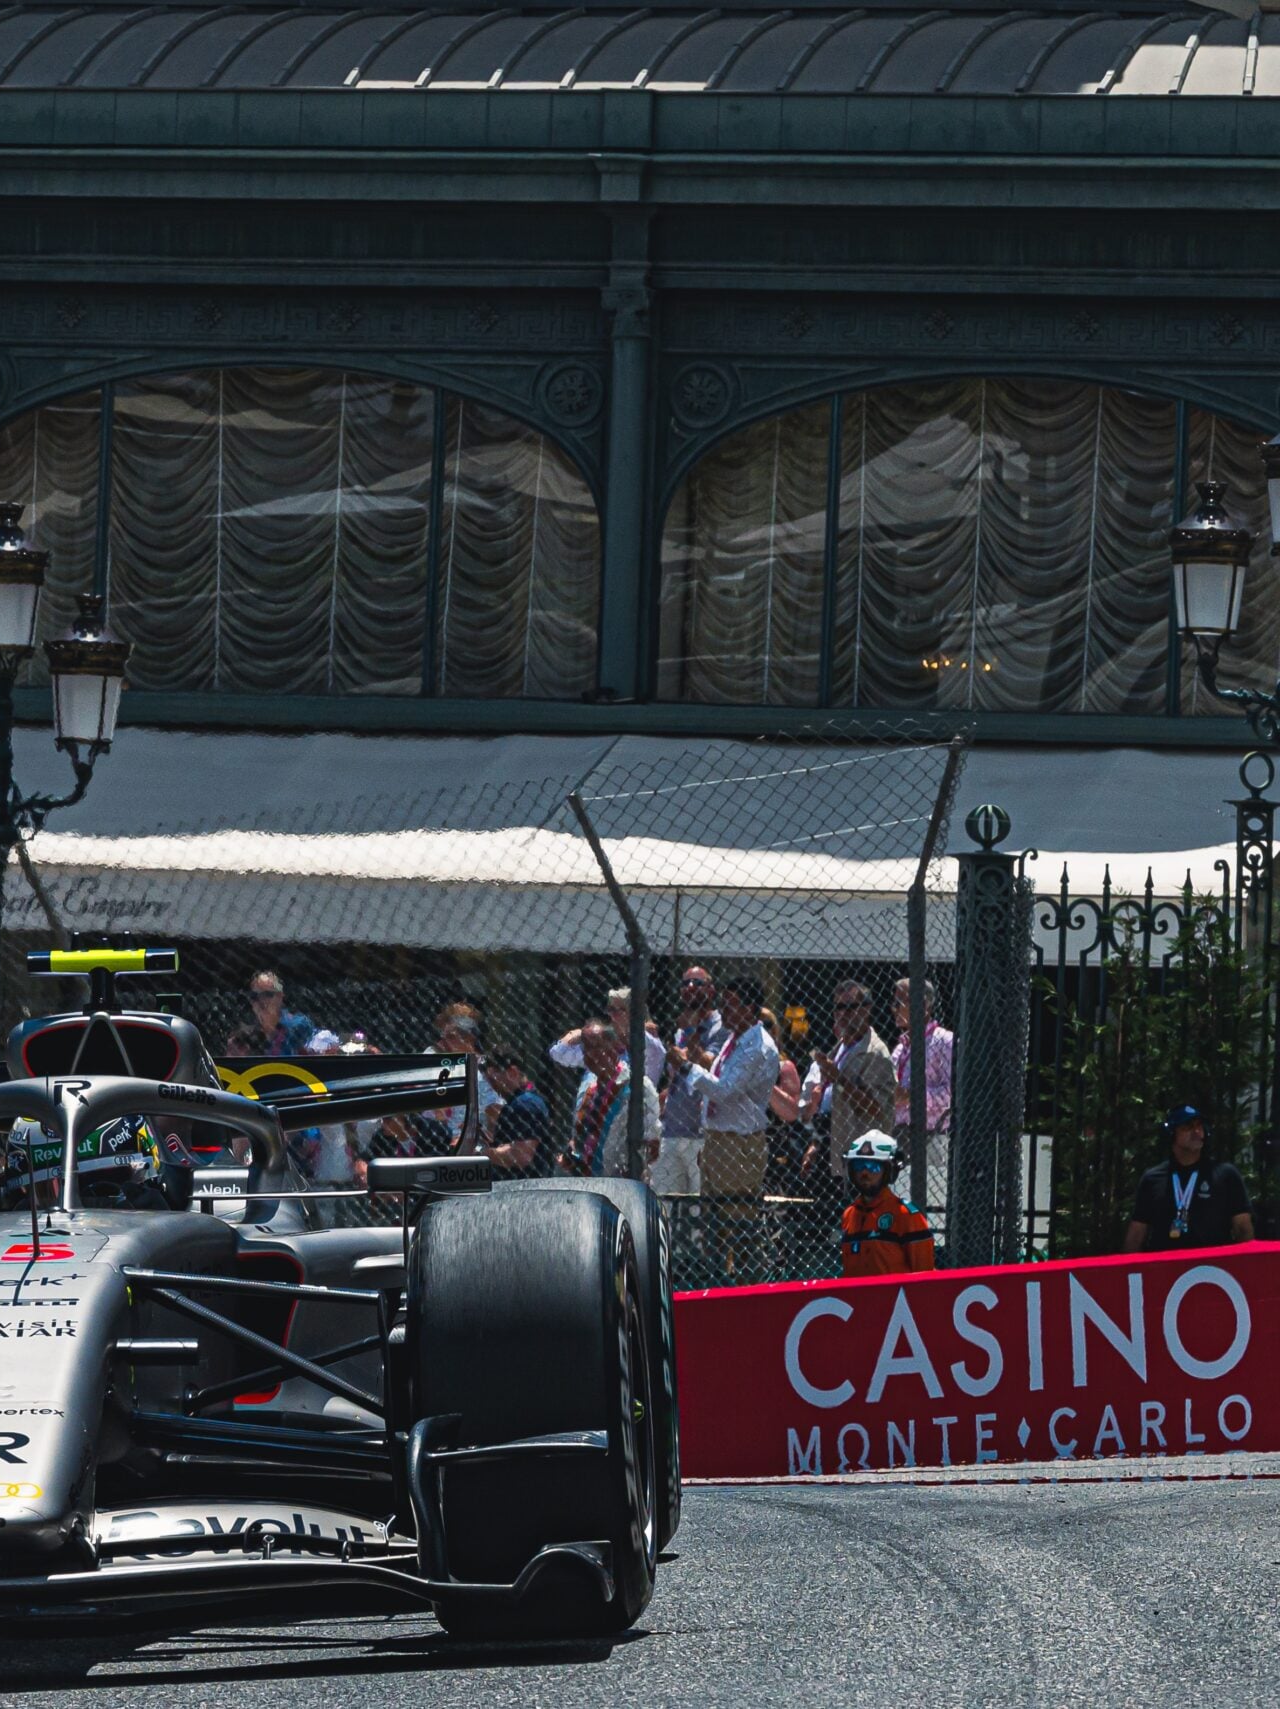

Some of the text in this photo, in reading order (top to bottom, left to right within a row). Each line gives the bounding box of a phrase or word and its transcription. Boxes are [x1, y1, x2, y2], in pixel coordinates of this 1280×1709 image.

[53, 1080, 92, 1107] R
[157, 1084, 217, 1106] Gillette
[440, 1163, 491, 1183] Revolu
[199, 1183, 241, 1195] Aleph
[0, 1243, 76, 1261] 5
[784, 1265, 1252, 1409] CASINO
[787, 1394, 1253, 1475] MONTE CARLO
